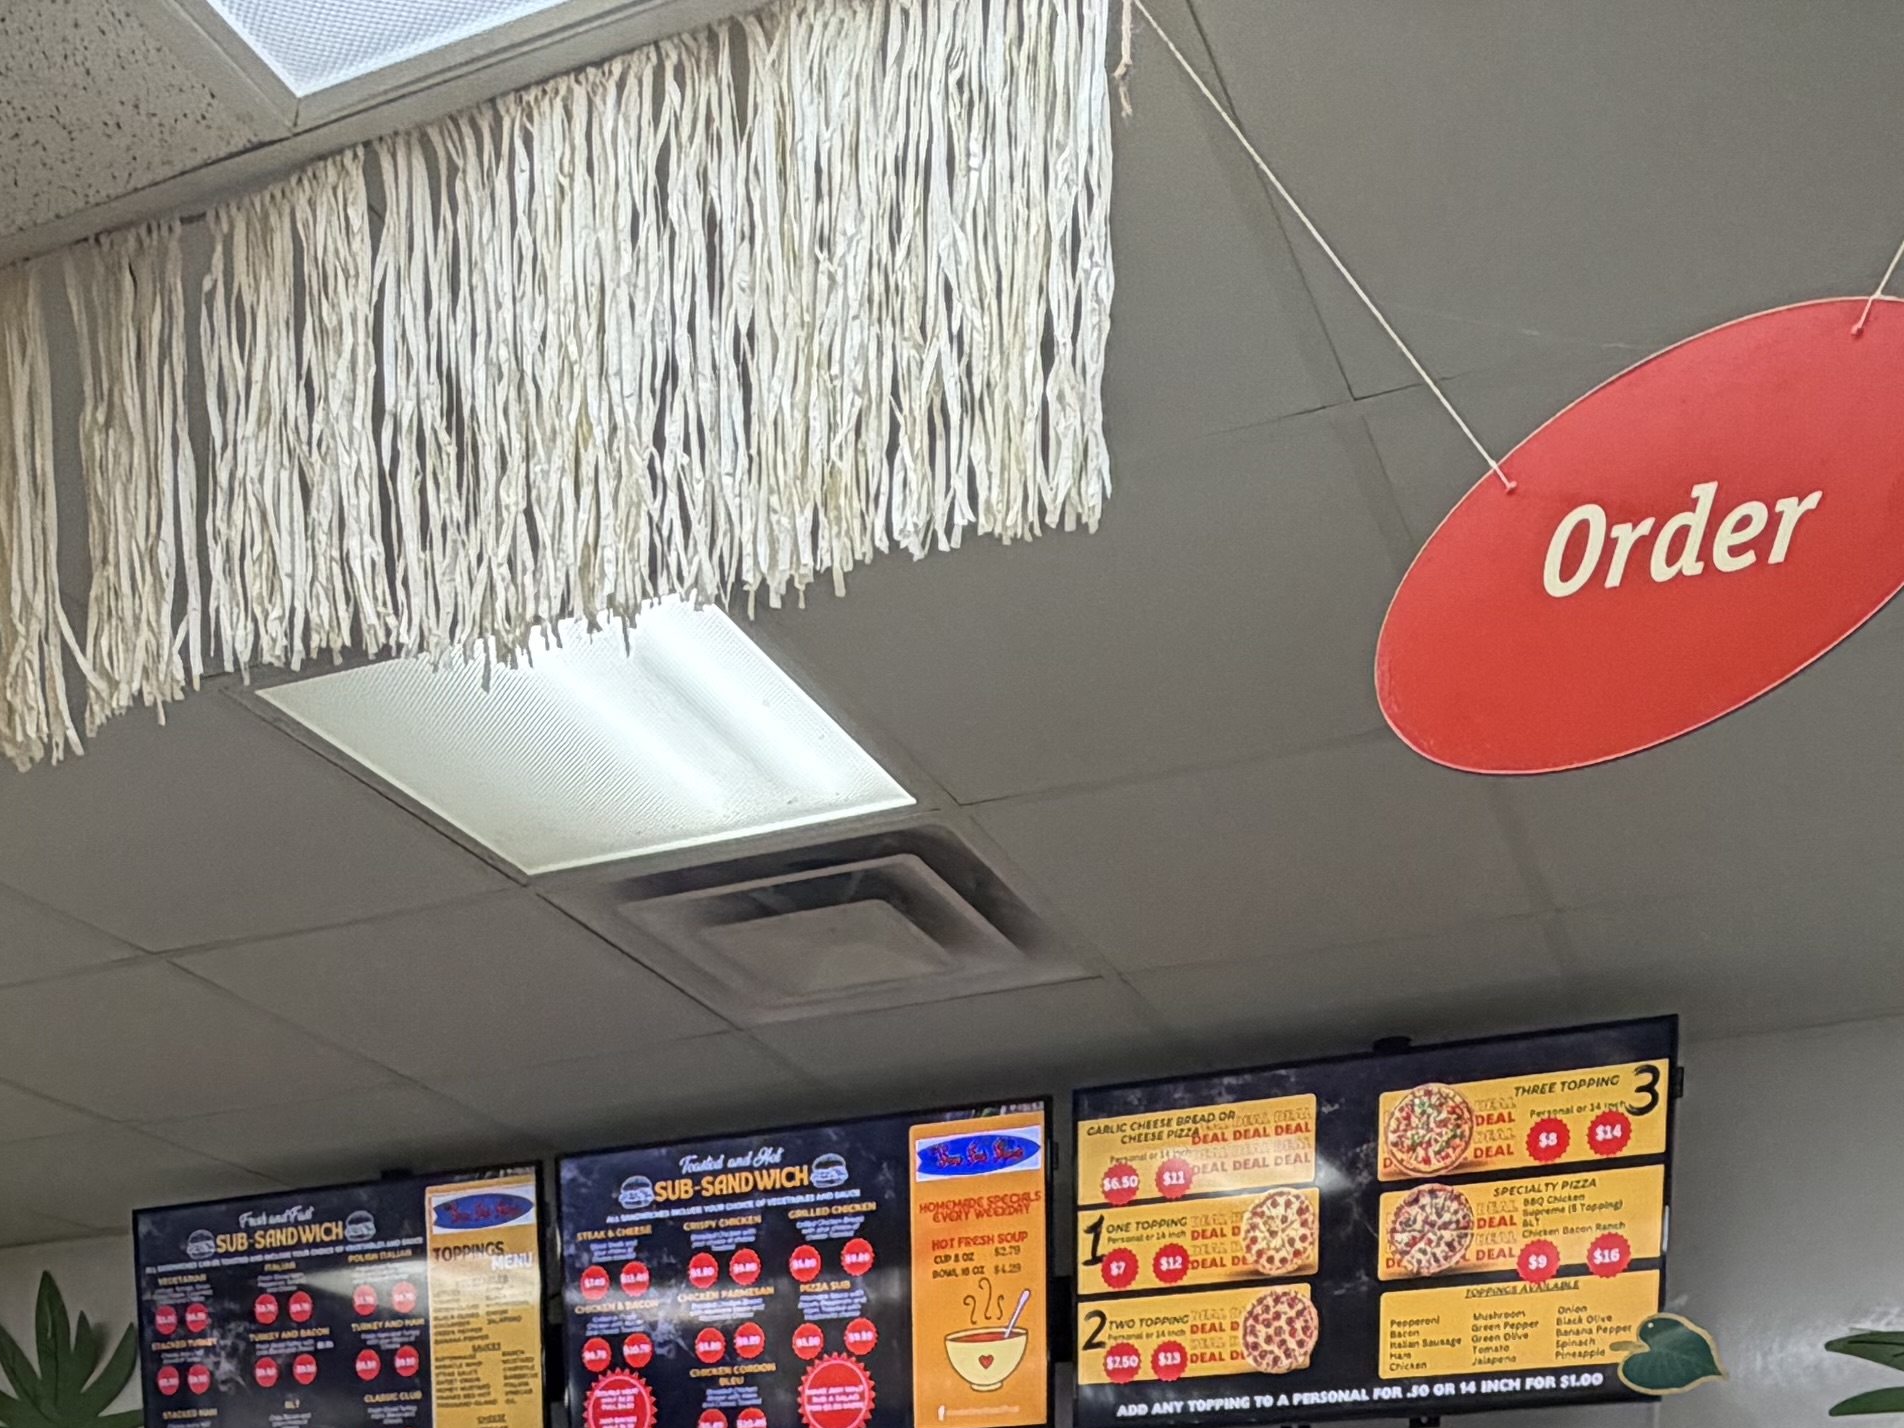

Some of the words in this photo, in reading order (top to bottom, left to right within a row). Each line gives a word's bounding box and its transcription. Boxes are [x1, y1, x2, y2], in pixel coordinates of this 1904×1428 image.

[1543, 481, 1823, 598] Order
[1514, 1082, 1557, 1097] THREE
[1560, 1075, 1621, 1092] TOPPING
[1625, 1064, 1660, 1116] 3
[1087, 1122, 1128, 1136] GARLIC
[1129, 1117, 1174, 1131] CHEESE
[1176, 1112, 1216, 1126] BREAD
[1218, 1110, 1236, 1121] OR
[1475, 1111, 1516, 1126] DEAL
[1120, 1131, 1164, 1145] CHEESE
[1167, 1127, 1200, 1139] PIZZA
[1191, 1131, 1228, 1145] DEAL
[1232, 1126, 1270, 1141] DEAL
[1274, 1121, 1311, 1136] DEAL
[1539, 1131, 1558, 1148] $8
[1596, 1124, 1622, 1142] $14
[727, 1150, 753, 1168] and
[1473, 1144, 1514, 1159] DEAL
[654, 1165, 809, 1202] SUB-SANDWICH
[1493, 1180, 1559, 1197] SPECIALTY
[1561, 1178, 1597, 1191] PIZZA
[1106, 1222, 1131, 1234] ONE
[1135, 1216, 1188, 1231] TOPPING
[1476, 1215, 1517, 1230] DEAL
[215, 1220, 343, 1254] SUB-SANDWICH
[932, 1237, 954, 1252] HOT
[957, 1233, 995, 1250] FRESH
[997, 1231, 1028, 1246] SOUP
[1082, 1214, 1106, 1267] 1
[1191, 1227, 1227, 1241] DEAL
[432, 1240, 504, 1262] TOPPINGS
[1476, 1247, 1516, 1261] DEAL
[1593, 1248, 1621, 1265] $16
[933, 1254, 952, 1265] CUP
[1160, 1255, 1183, 1271] $12
[1190, 1257, 1226, 1270] DEAL
[1528, 1254, 1548, 1270] $9
[1557, 1305, 1588, 1315] Onion
[1139, 1314, 1190, 1328] TOPPING
[1190, 1321, 1225, 1335] DEAL
[1390, 1315, 1440, 1328] Pepperoni
[1503, 1320, 1539, 1331] Pepper
[1082, 1309, 1107, 1351] 2
[1390, 1329, 1420, 1339] Bacon
[1596, 1324, 1632, 1335] Pepper
[1422, 1337, 1462, 1348] Sausage
[1472, 1344, 1510, 1355] Tomato
[1190, 1351, 1225, 1364] DEAL
[1389, 1361, 1428, 1372] Chicken
[1116, 1404, 1148, 1418] ADD
[1151, 1401, 1185, 1415] ANY
[1188, 1395, 1250, 1413] TOPPING
[1253, 1395, 1274, 1408] TO
[1276, 1394, 1290, 1406] A
[1292, 1387, 1370, 1406] PERSONAL
[1373, 1386, 1403, 1401] FOR
[1433, 1382, 1456, 1397] OR
[1459, 1380, 1477, 1395] 14
[1480, 1377, 1521, 1393] INCH
[1525, 1374, 1557, 1390] FOR
[1559, 1373, 1604, 1389] $1.00
